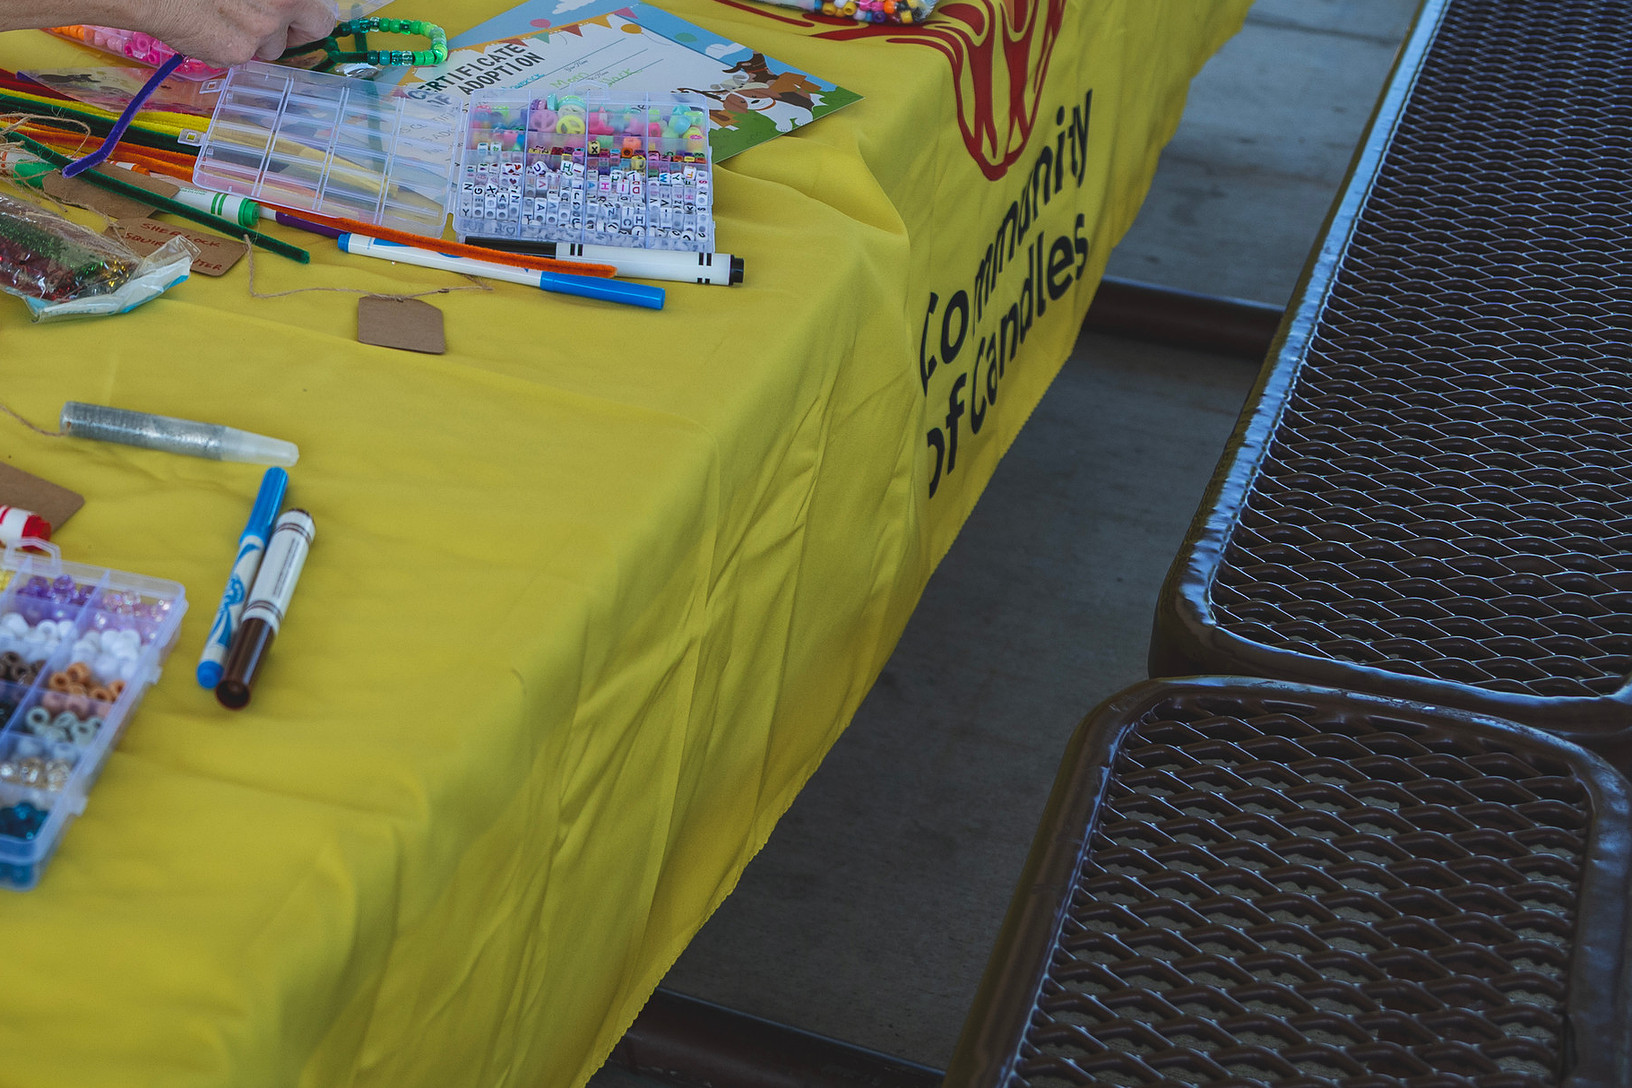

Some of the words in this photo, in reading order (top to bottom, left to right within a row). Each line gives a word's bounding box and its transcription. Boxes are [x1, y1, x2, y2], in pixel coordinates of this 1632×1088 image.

[408, 43, 526, 100] CERTIFICATE
[457, 51, 546, 96] ADOPTION
[920, 88, 1093, 397] Community
[971, 213, 1089, 435] Candles
